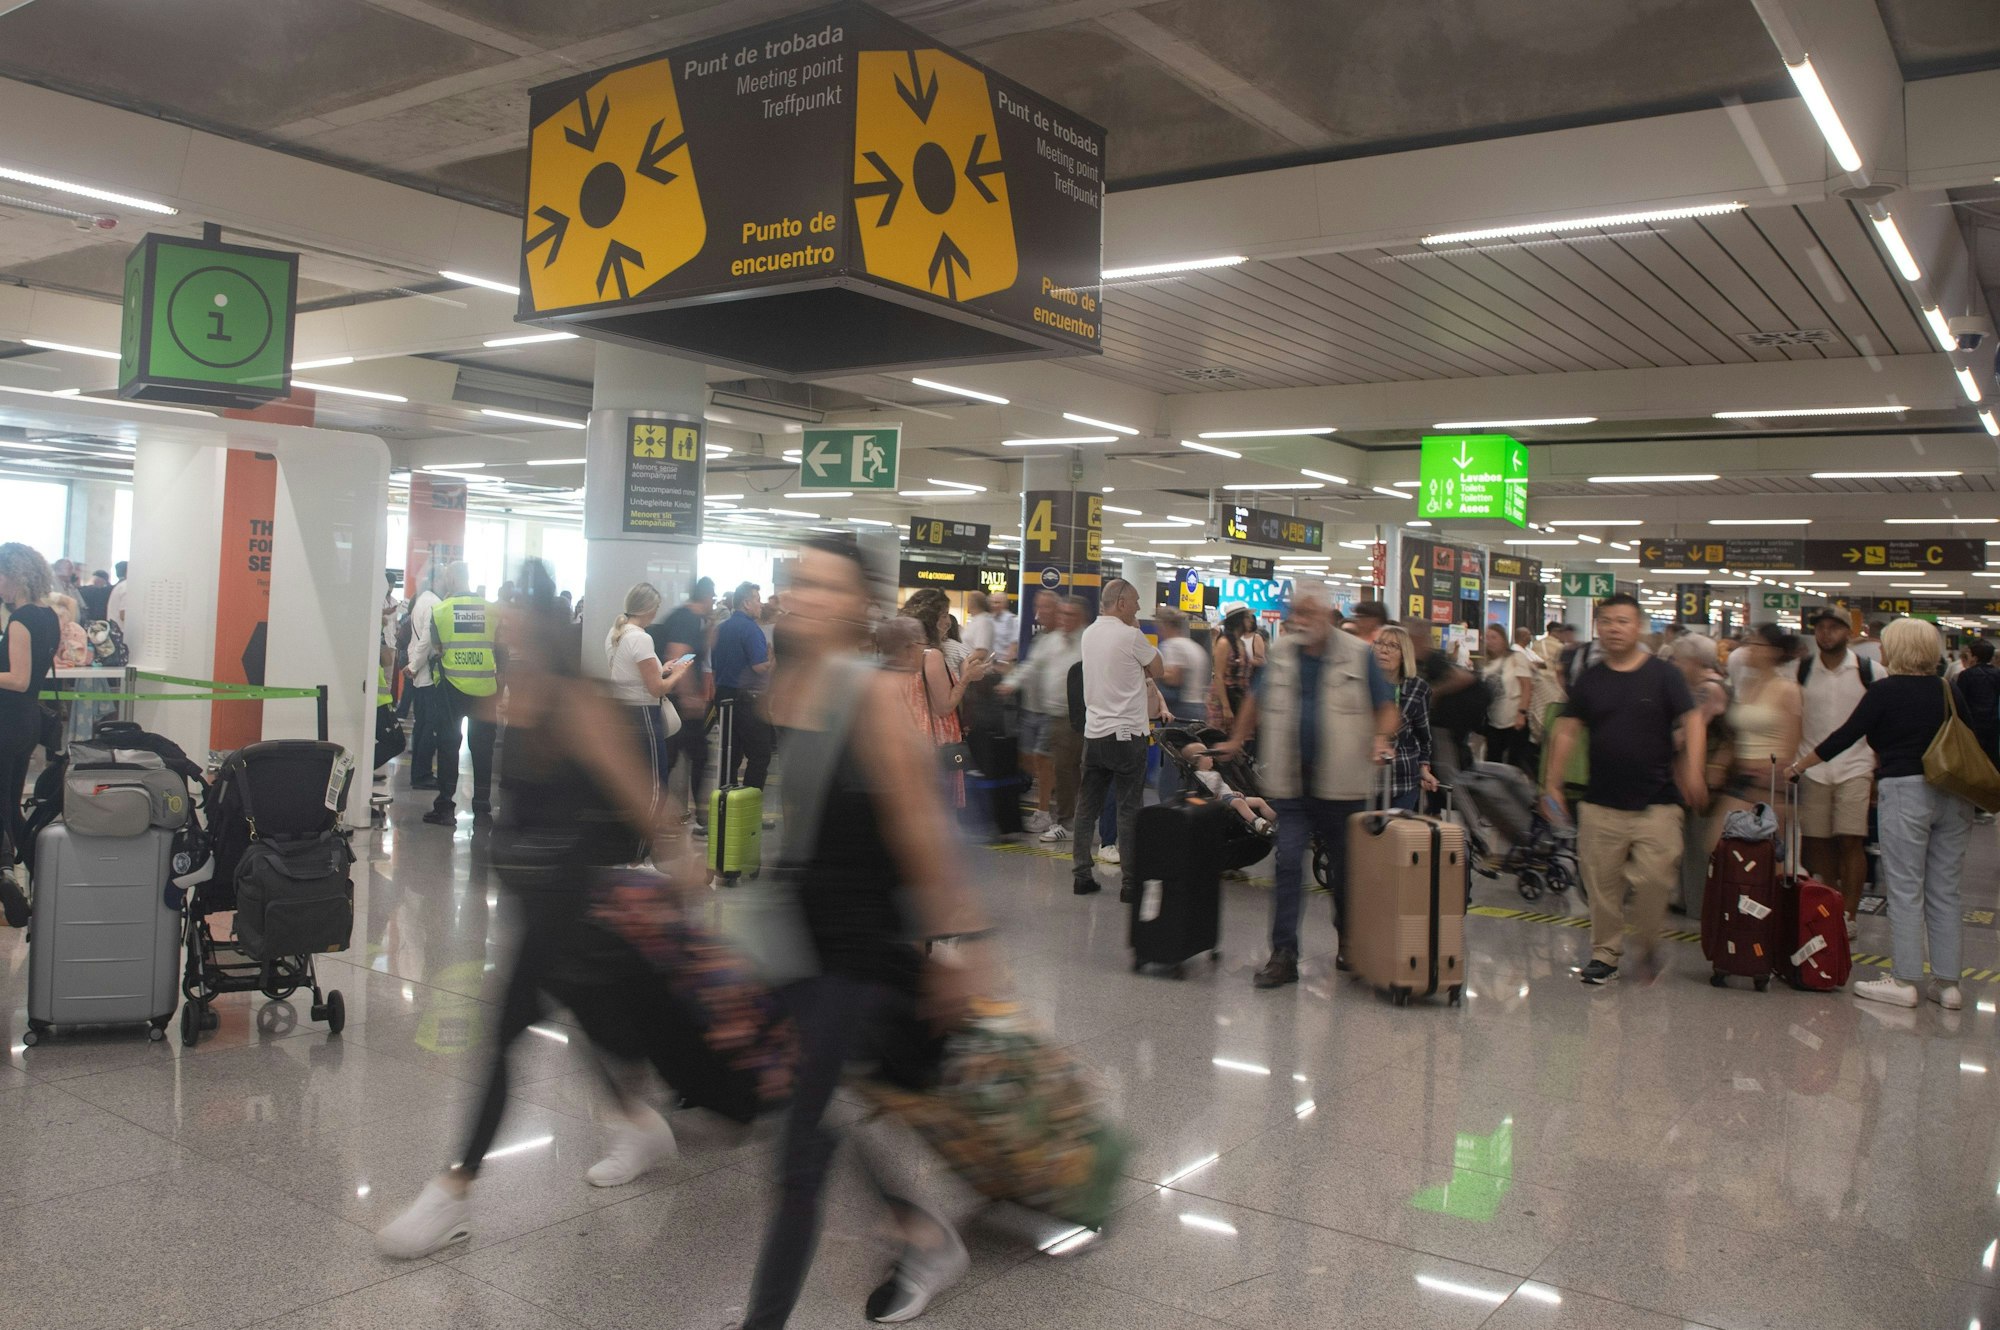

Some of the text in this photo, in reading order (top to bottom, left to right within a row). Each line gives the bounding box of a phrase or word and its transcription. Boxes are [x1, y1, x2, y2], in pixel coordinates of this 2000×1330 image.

[685, 25, 844, 80] Punt de trobada
[737, 53, 844, 96] Meeting point
[762, 85, 843, 119] Treffpunkt
[998, 90, 1098, 156] Punt de trobada
[1037, 137, 1098, 182] Meeting point
[1053, 172, 1098, 208] Treffpunkt
[742, 211, 836, 244] Punto de
[731, 245, 835, 276] encuentro
[1042, 276, 1096, 312] Punto de
[1033, 306, 1095, 338] encuentro
[631, 471, 677, 480] acompanyant
[632, 463, 678, 473] Menors sense
[1460, 472, 1503, 482] Lavabos
[630, 485, 682, 495] Unaccompanied
[1461, 484, 1486, 492] Toilets
[630, 498, 673, 508] Unbegleitete
[1459, 503, 1490, 513] Aseos
[630, 510, 660, 519] Menores
[1026, 499, 1057, 552] 4
[1926, 546, 1943, 565] C
[980, 570, 1007, 585] PAUL
[1681, 592, 1698, 616] 3
[453, 612, 486, 621] Trablisa
[454, 651, 484, 665] SEGURIDAD
